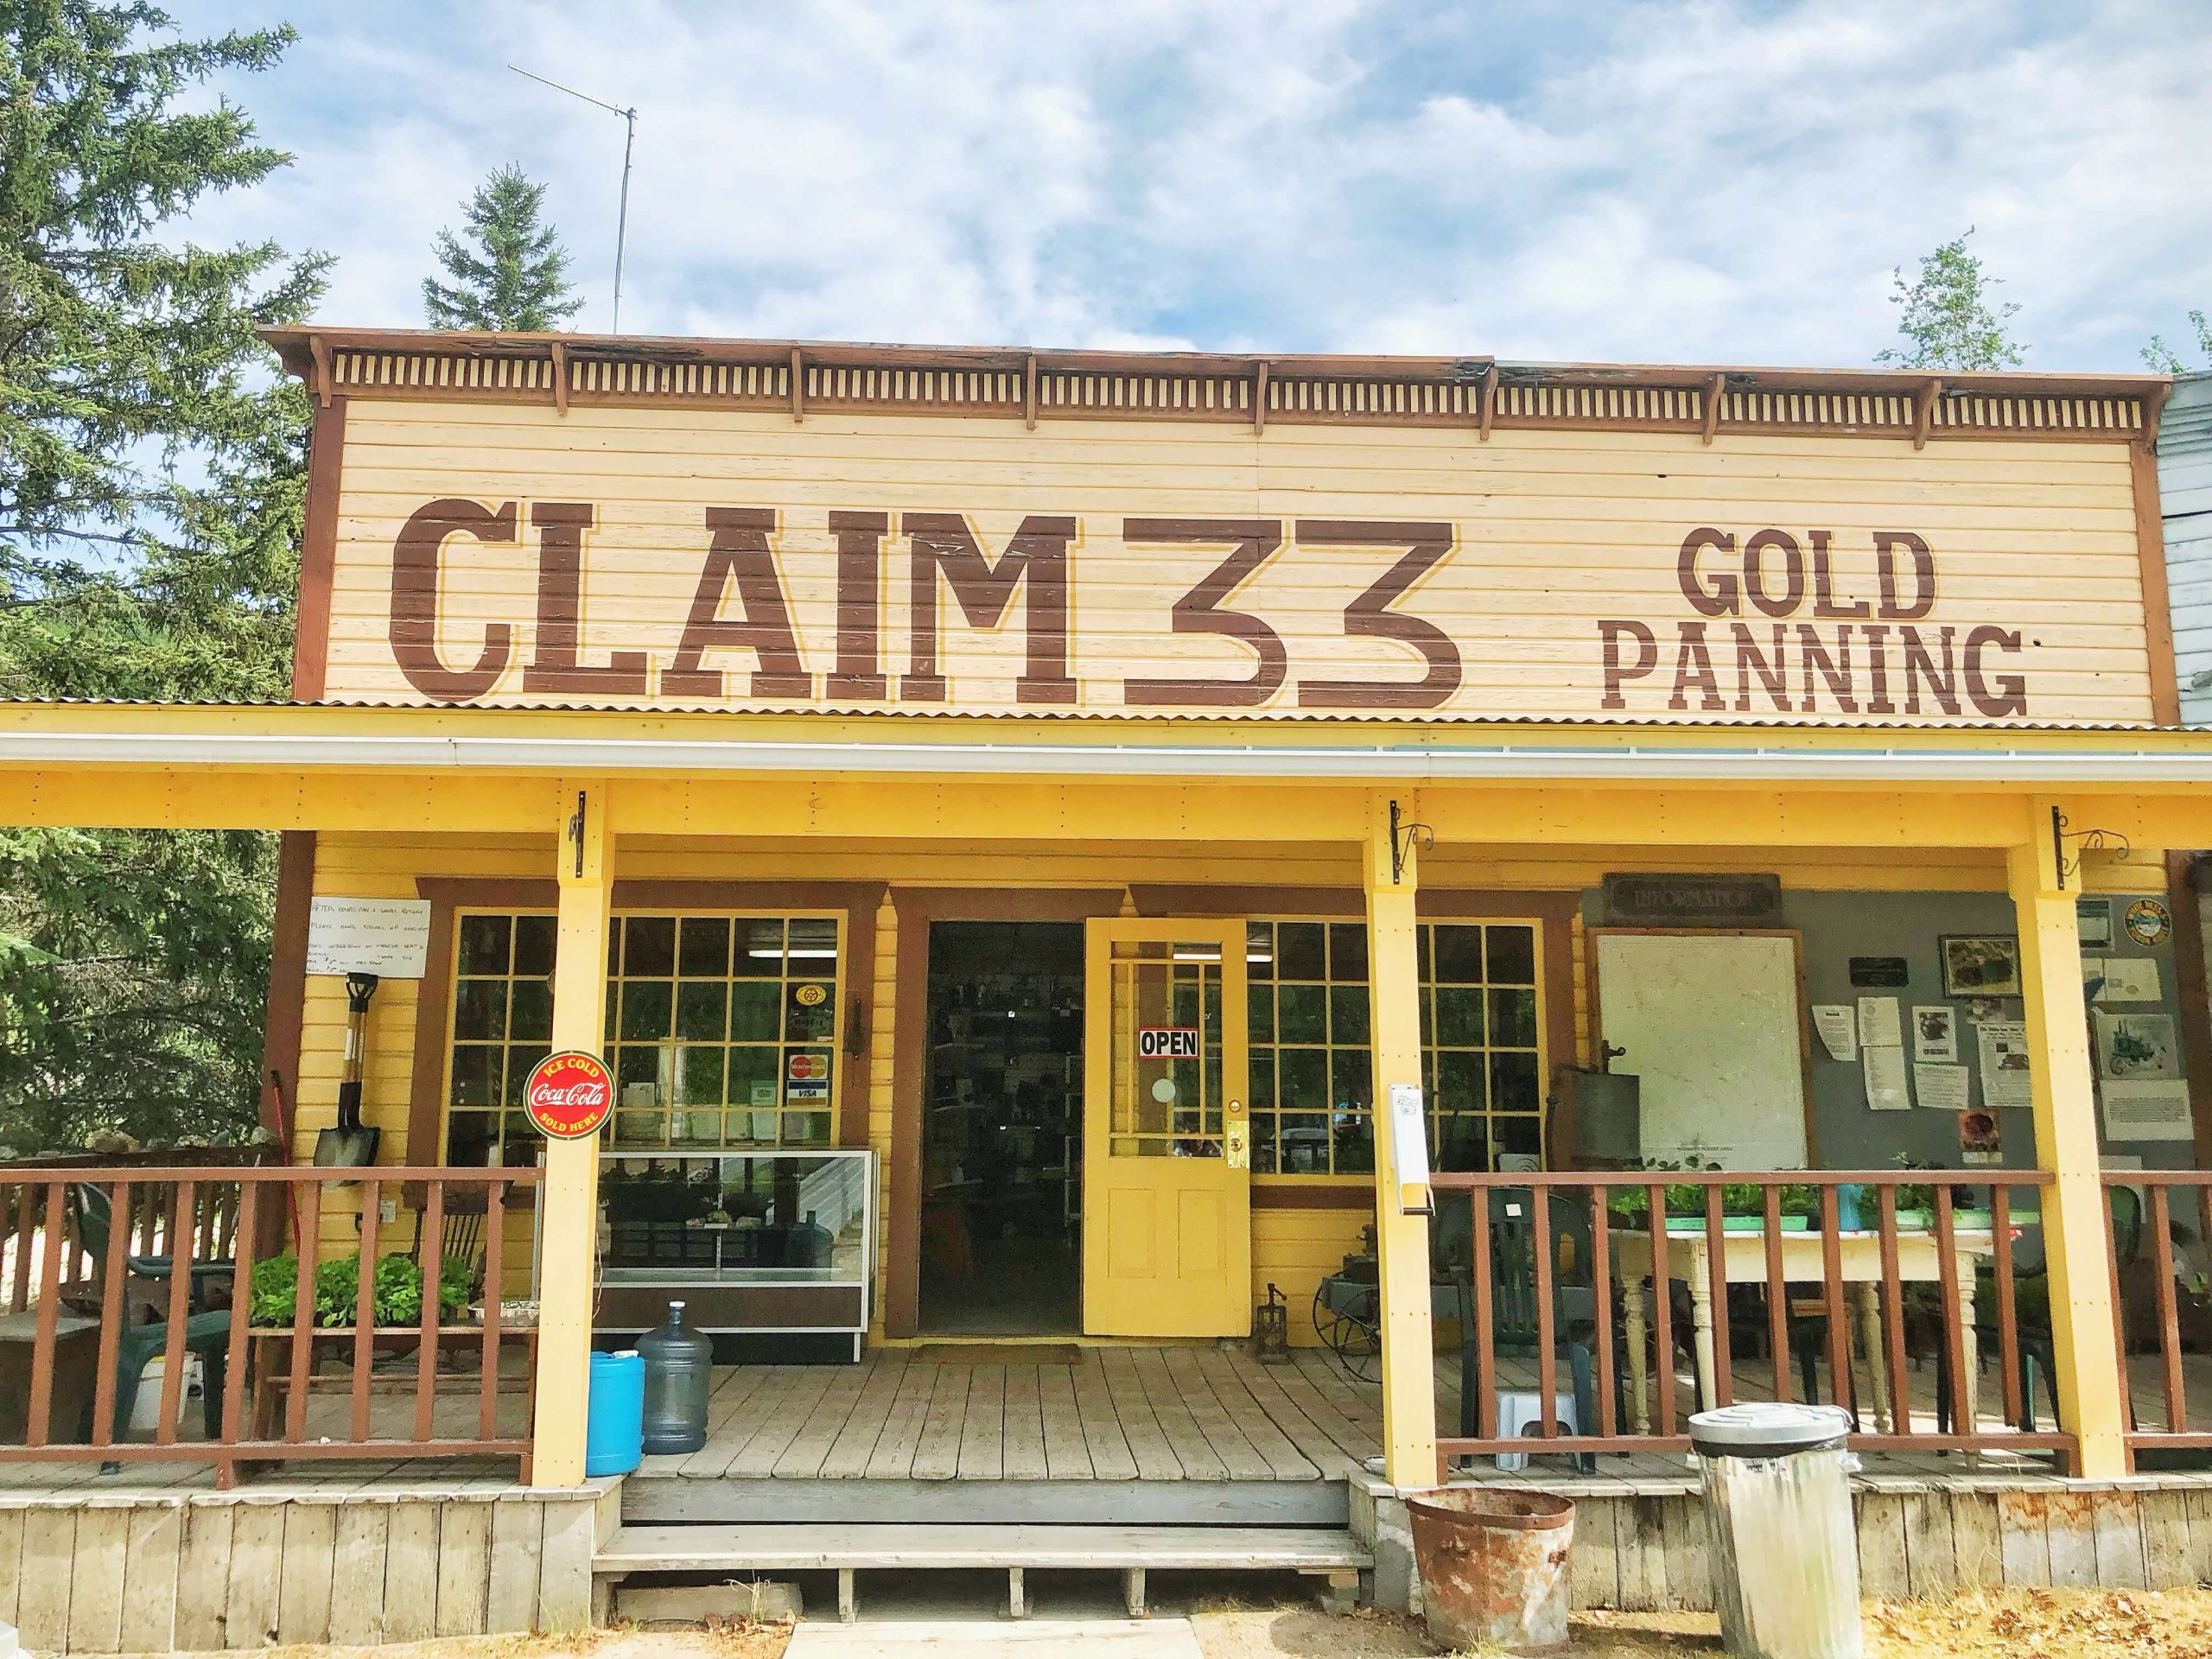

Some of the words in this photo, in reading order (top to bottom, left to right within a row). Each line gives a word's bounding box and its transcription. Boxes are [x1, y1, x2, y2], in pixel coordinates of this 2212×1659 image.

[1677, 526, 1936, 620] GOLD
[389, 498, 1080, 703] CLAIM
[1122, 518, 1463, 709] 33
[1597, 619, 2027, 717] PANNING
[1141, 1031, 1197, 1055] OPEN
[543, 1059, 566, 1078] ICE
[567, 1058, 601, 1078] COLD
[531, 1082, 607, 1107] Coca-Cola
[539, 1112, 567, 1132] SOLD
[569, 1112, 599, 1132] HERE
